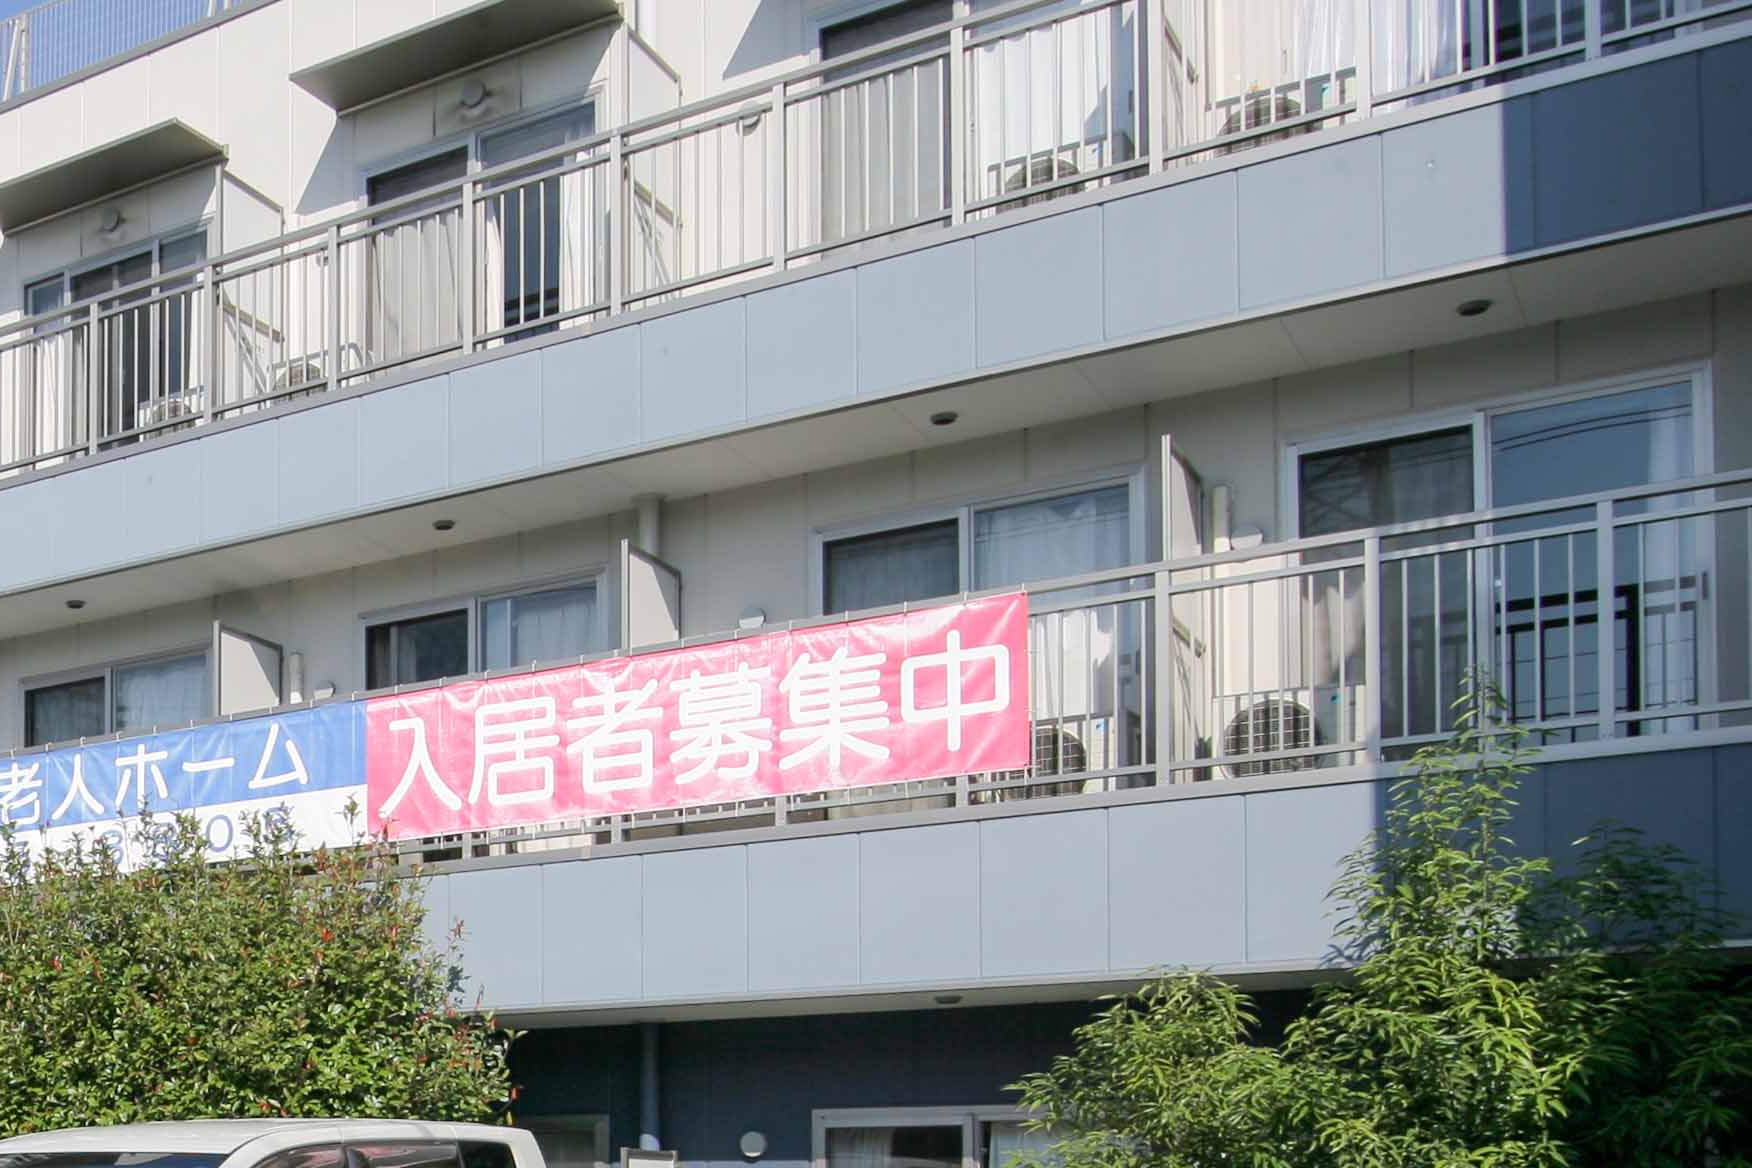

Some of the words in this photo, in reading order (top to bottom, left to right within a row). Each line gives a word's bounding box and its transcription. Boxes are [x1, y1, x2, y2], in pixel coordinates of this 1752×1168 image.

[376, 628, 1010, 820] 入居者募集中
